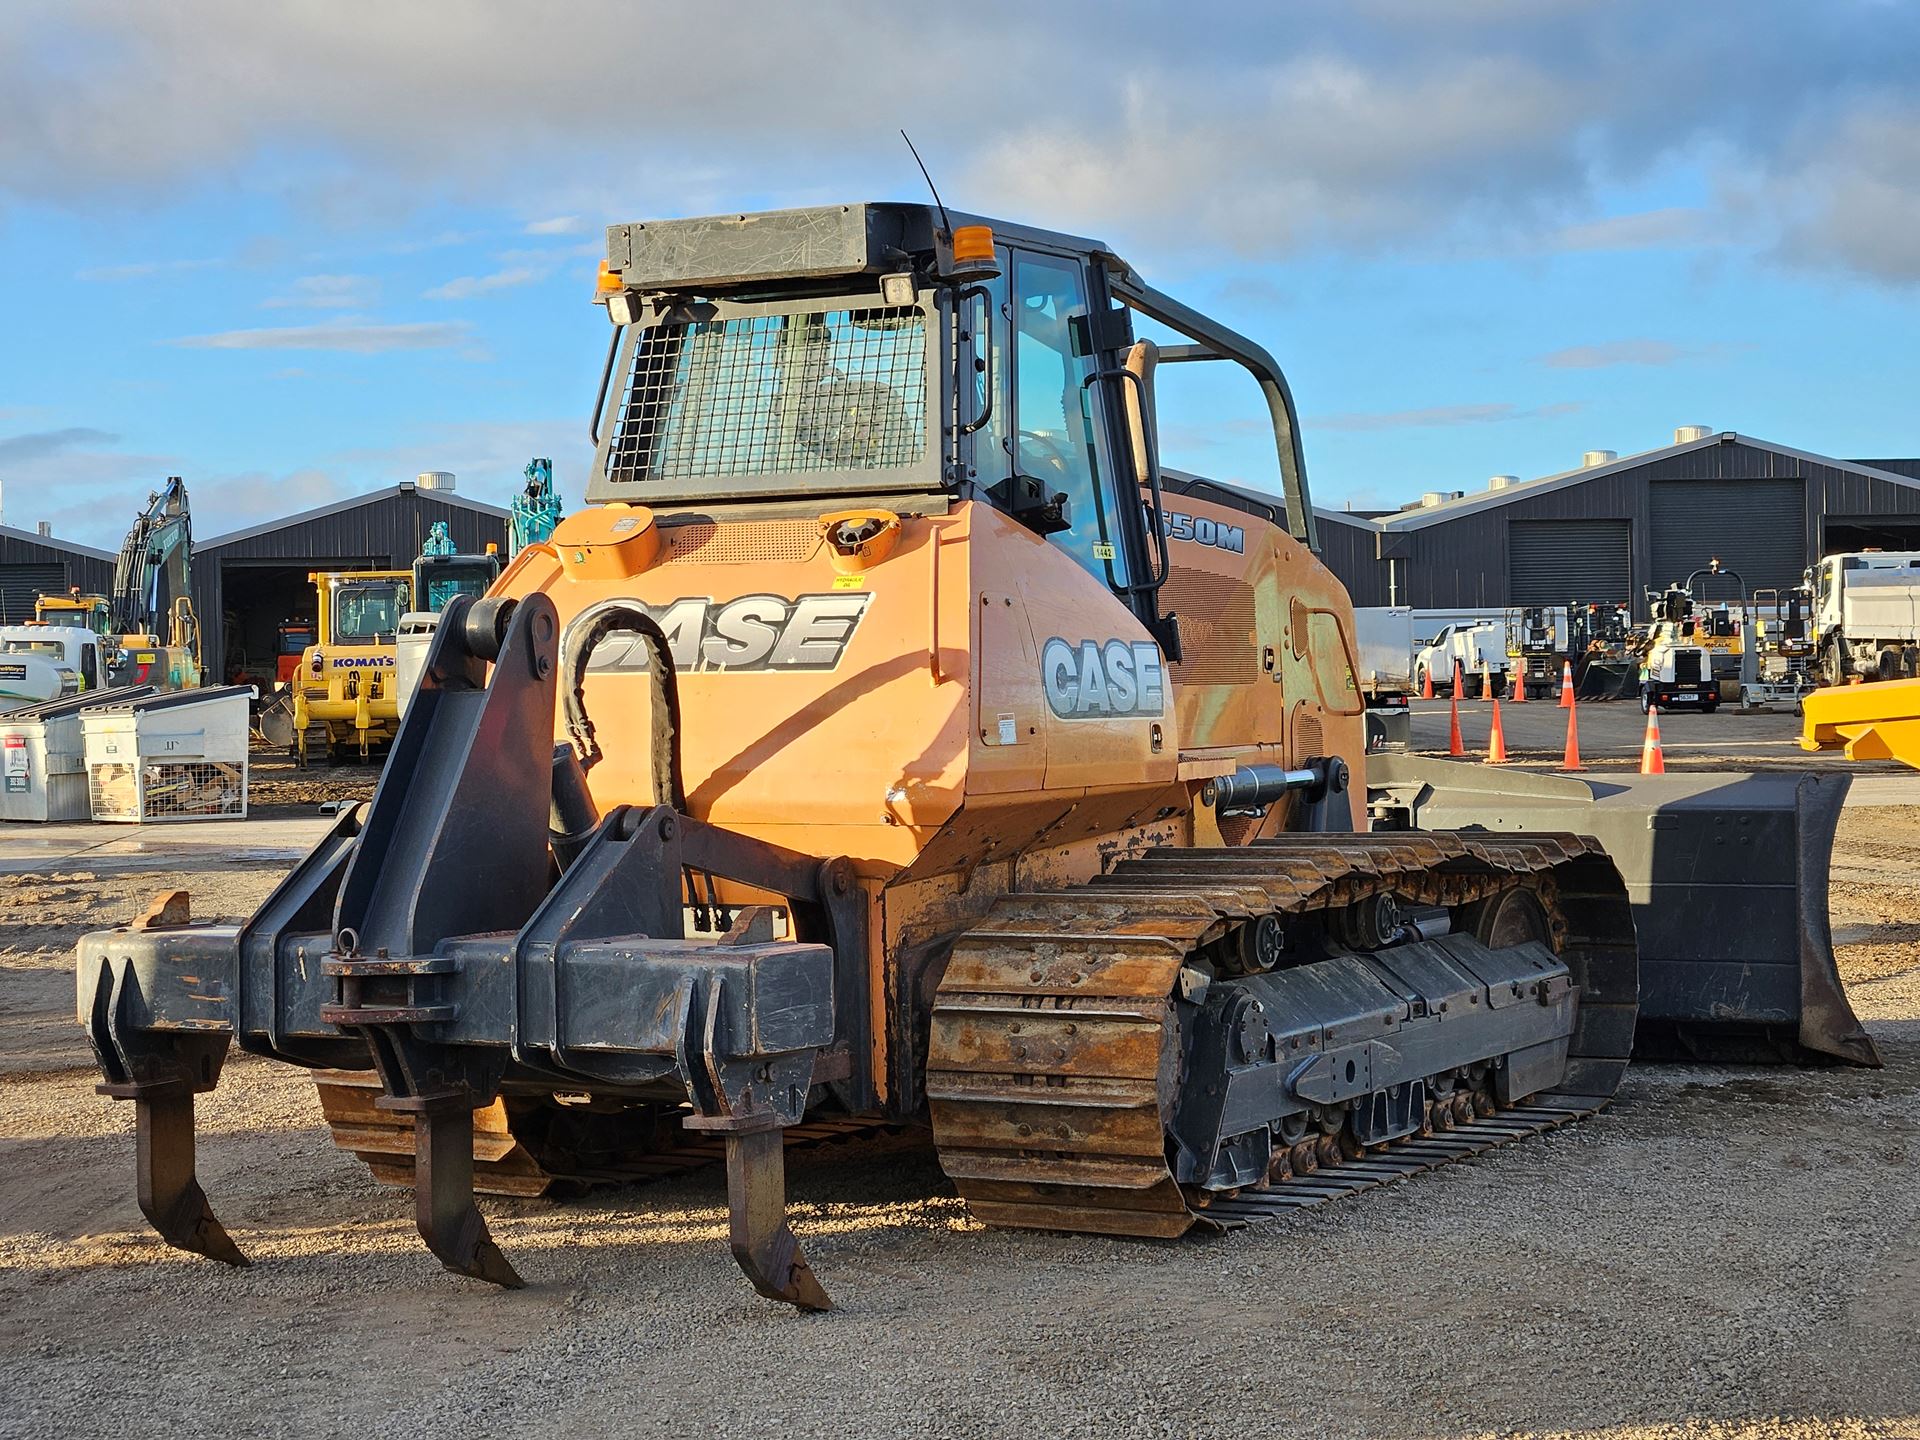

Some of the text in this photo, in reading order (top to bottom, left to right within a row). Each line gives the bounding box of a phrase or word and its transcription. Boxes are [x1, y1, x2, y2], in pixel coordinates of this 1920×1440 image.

[1096, 547, 1112, 558] 1442
[333, 656, 397, 668] KOMATS
[1042, 637, 1164, 716] CASE
